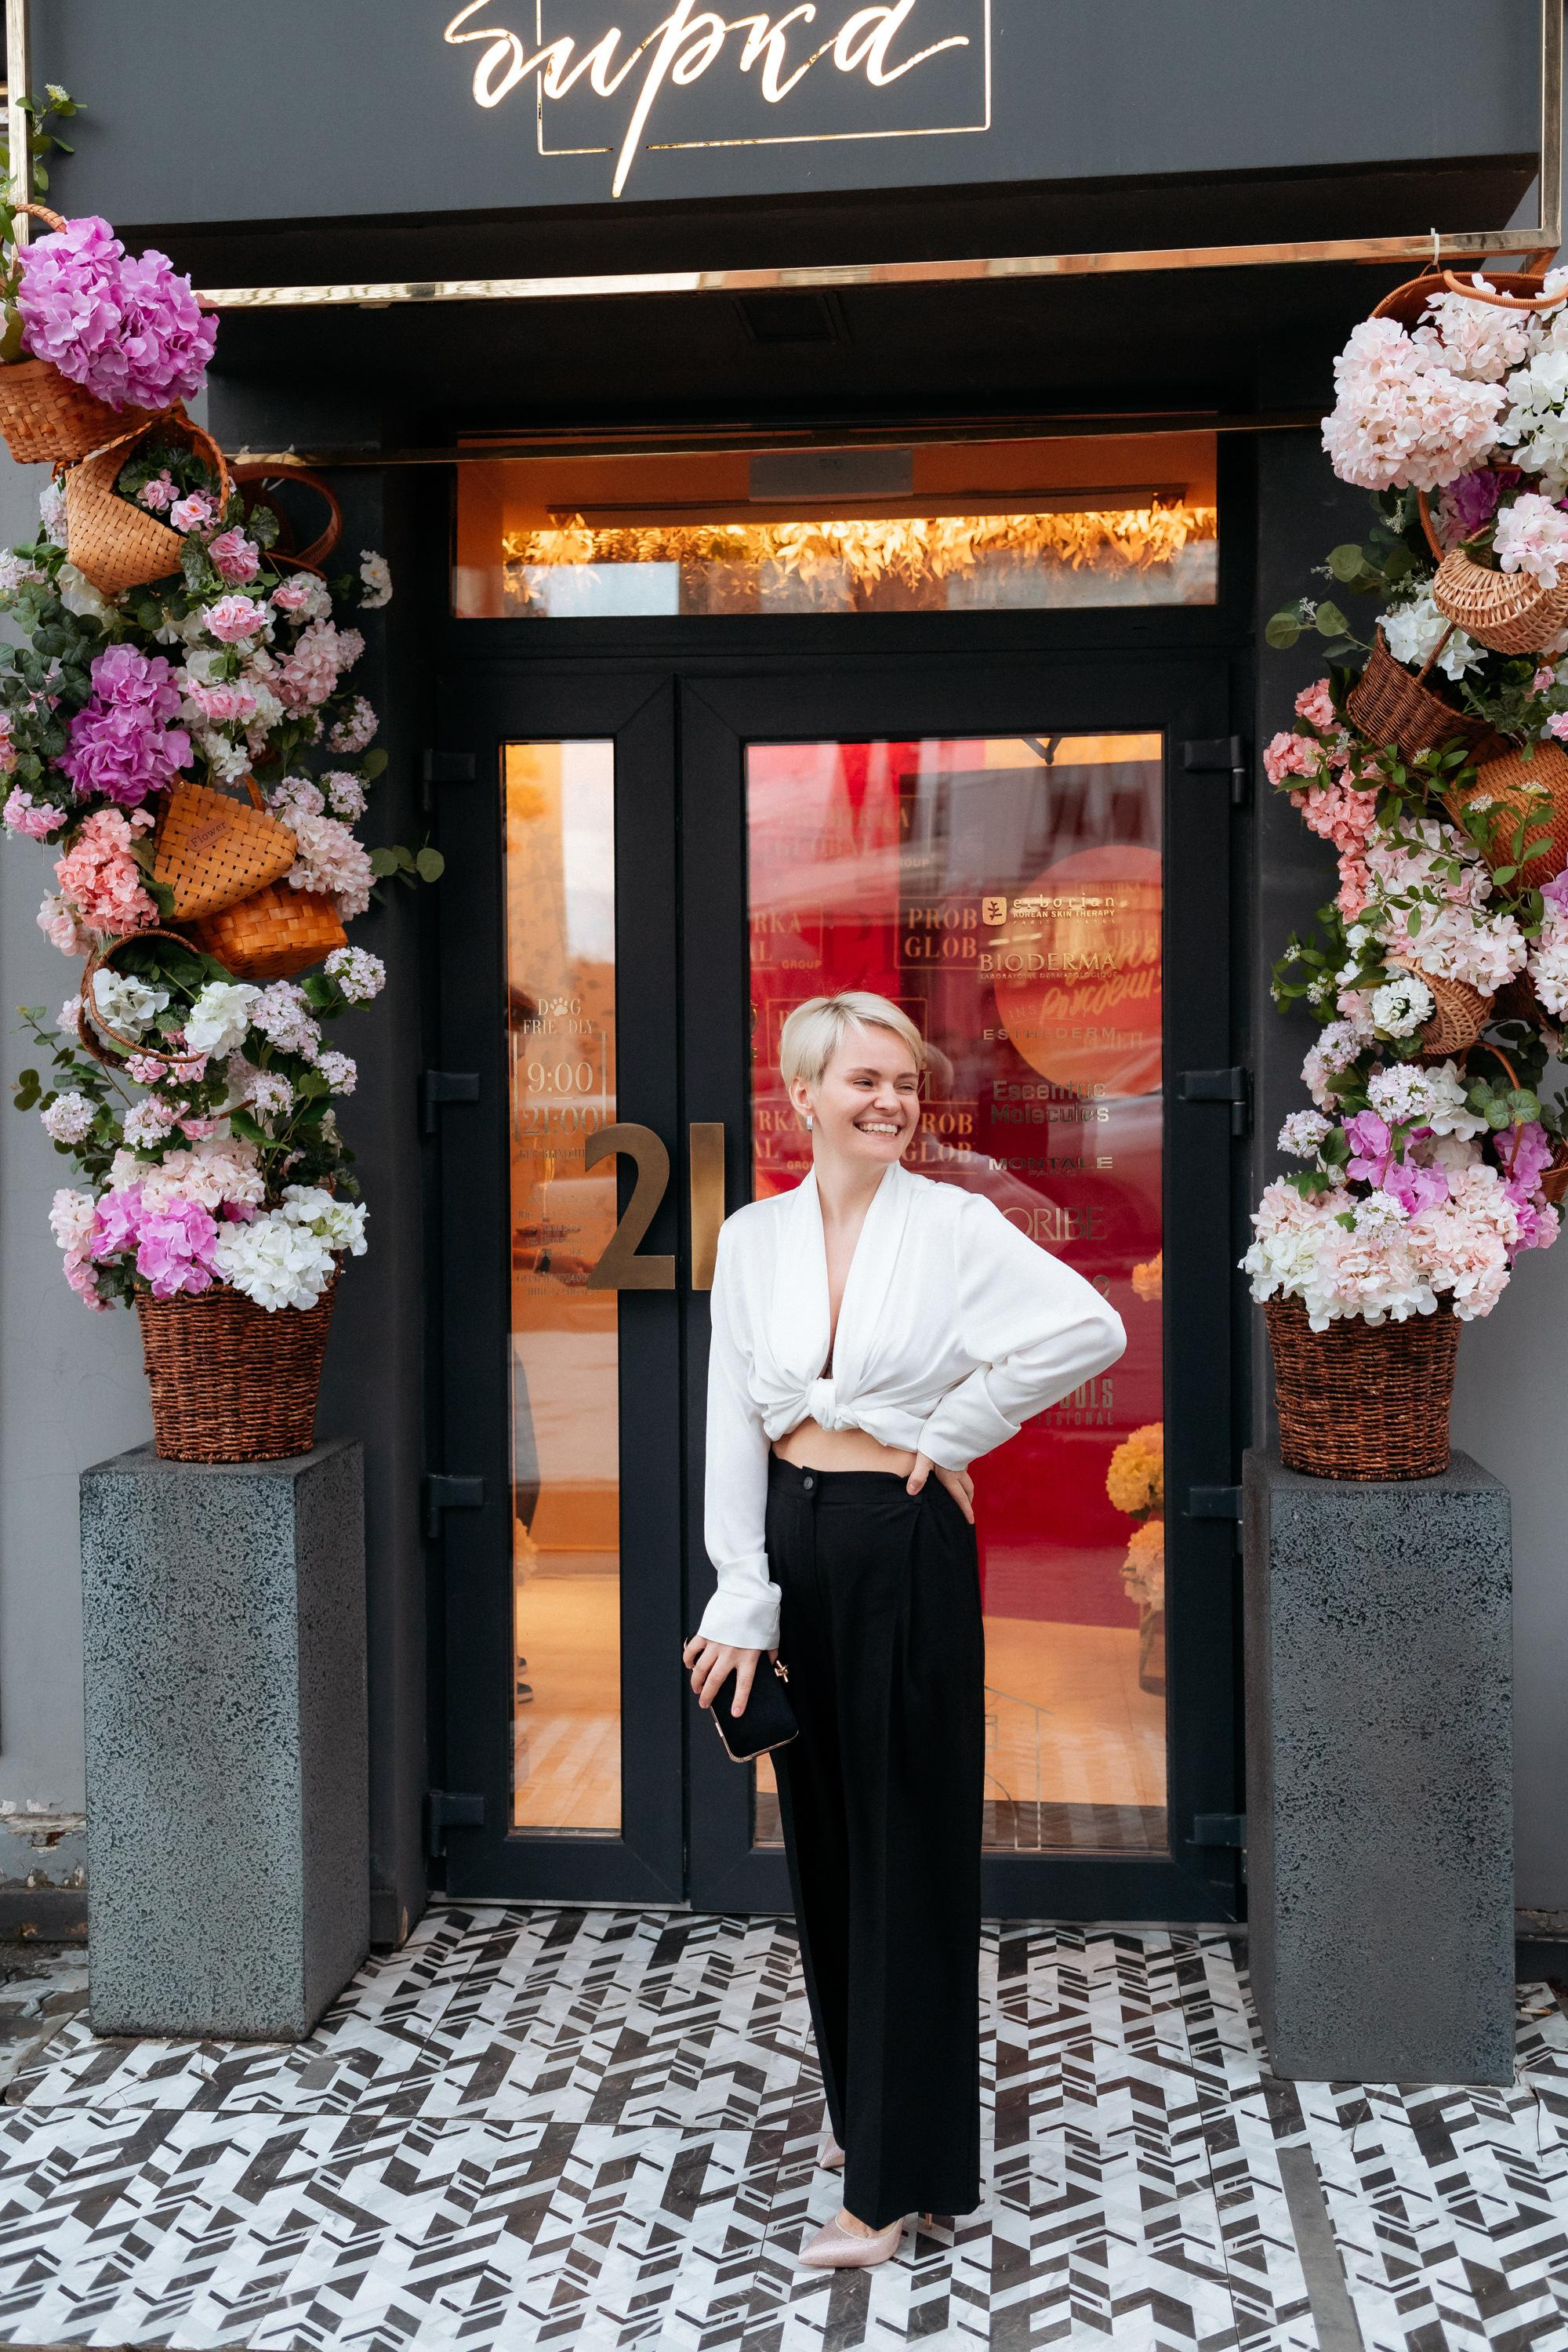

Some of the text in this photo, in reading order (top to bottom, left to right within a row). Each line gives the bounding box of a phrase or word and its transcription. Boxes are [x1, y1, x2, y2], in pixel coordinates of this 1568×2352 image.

[191, 821, 227, 848] Flower
[1013, 892, 1116, 909] erborian
[1076, 909, 1116, 917] THERAPY
[781, 959, 823, 970] GROUP
[980, 953, 1117, 972] BIODERMA
[523, 1019, 595, 1035] FRIEDLY
[527, 1062, 593, 1093] 9:00
[993, 1079, 1106, 1102] Escentric
[523, 1103, 598, 1136] 21:00
[921, 1112, 973, 1135] ROB
[991, 1102, 1109, 1124] Molecules
[786, 1160, 812, 1170] GRO
[989, 1156, 1114, 1171] MONTALE
[585, 1123, 724, 1291] 21
[1002, 1207, 1108, 1241] ORIBE
